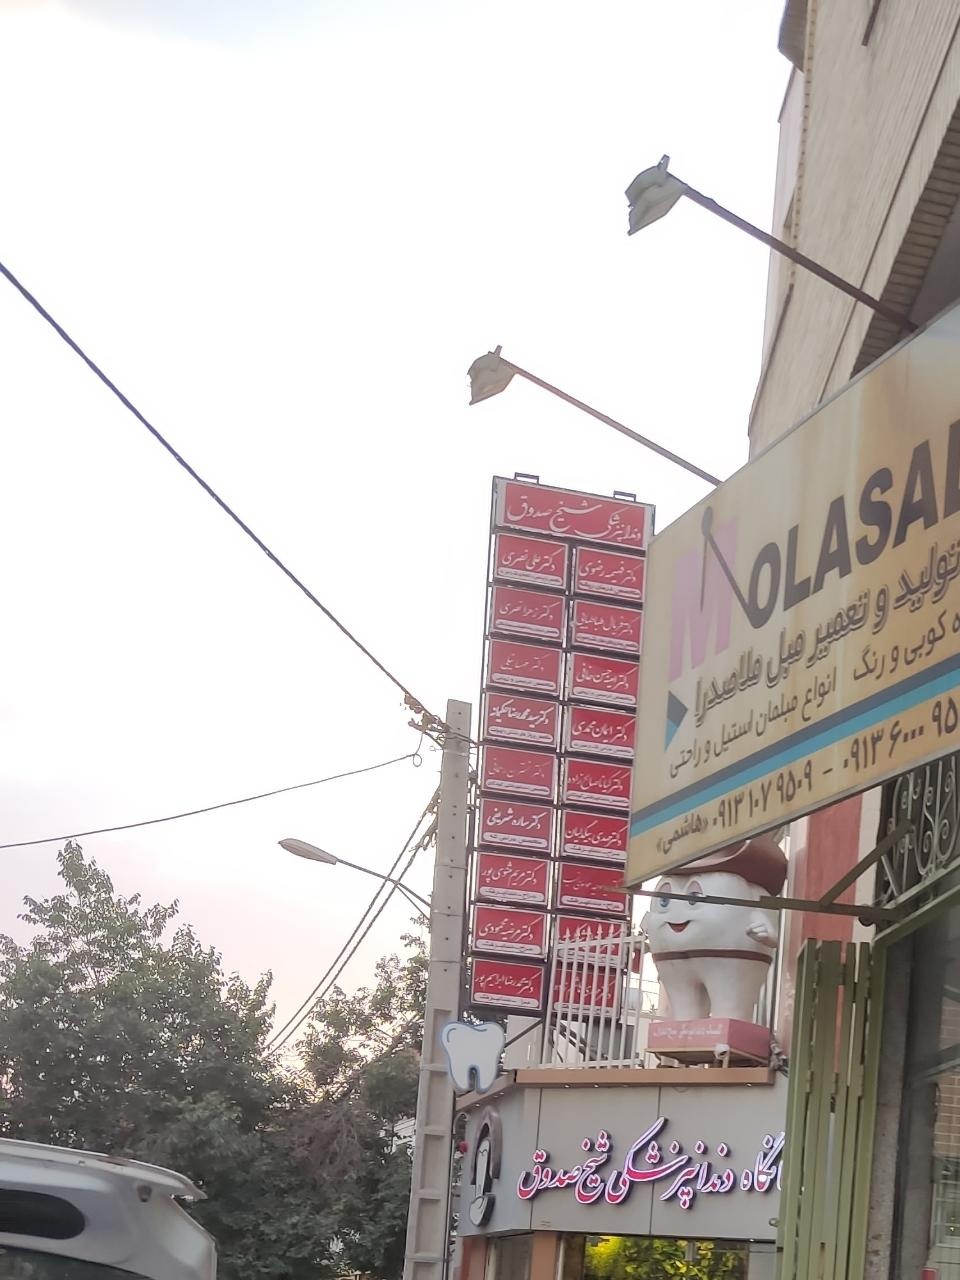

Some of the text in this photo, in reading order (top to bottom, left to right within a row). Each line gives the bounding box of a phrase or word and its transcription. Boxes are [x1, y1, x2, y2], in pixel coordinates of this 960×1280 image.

[507, 496, 552, 521] صدوق
[549, 499, 603, 533] شیخ
[539, 548, 563, 573] دکتر
[621, 565, 641, 585] دکتر
[537, 601, 561, 620] دکتر
[872, 583, 891, 636] و
[806, 588, 870, 670] تعمیر
[904, 609, 947, 666] کوبی
[766, 628, 806, 689] مبل
[852, 644, 886, 681] رنگ
[889, 645, 900, 674] و
[613, 667, 638, 690] دکتر
[694, 646, 762, 729] ملاصدرا
[802, 666, 838, 722] انواع
[535, 706, 555, 725] دکتر
[572, 721, 597, 736] محمدی
[755, 694, 799, 738] مبلمان
[610, 718, 636, 743] دکتر
[714, 709, 754, 758] استیل
[670, 738, 703, 780] راحتی
[703, 740, 712, 764] و
[608, 771, 631, 793] دکتر
[486, 807, 514, 826] شریفی
[526, 811, 548, 829] دکتر
[607, 824, 629, 847] دکتر
[520, 863, 545, 886] دکتر
[515, 915, 544, 942] دکتر
[518, 970, 542, 995] دکتر
[516, 1149, 582, 1200] صدوق
[575, 1129, 608, 1204] شیخ
[605, 1116, 734, 1209] دندانپزشکی
